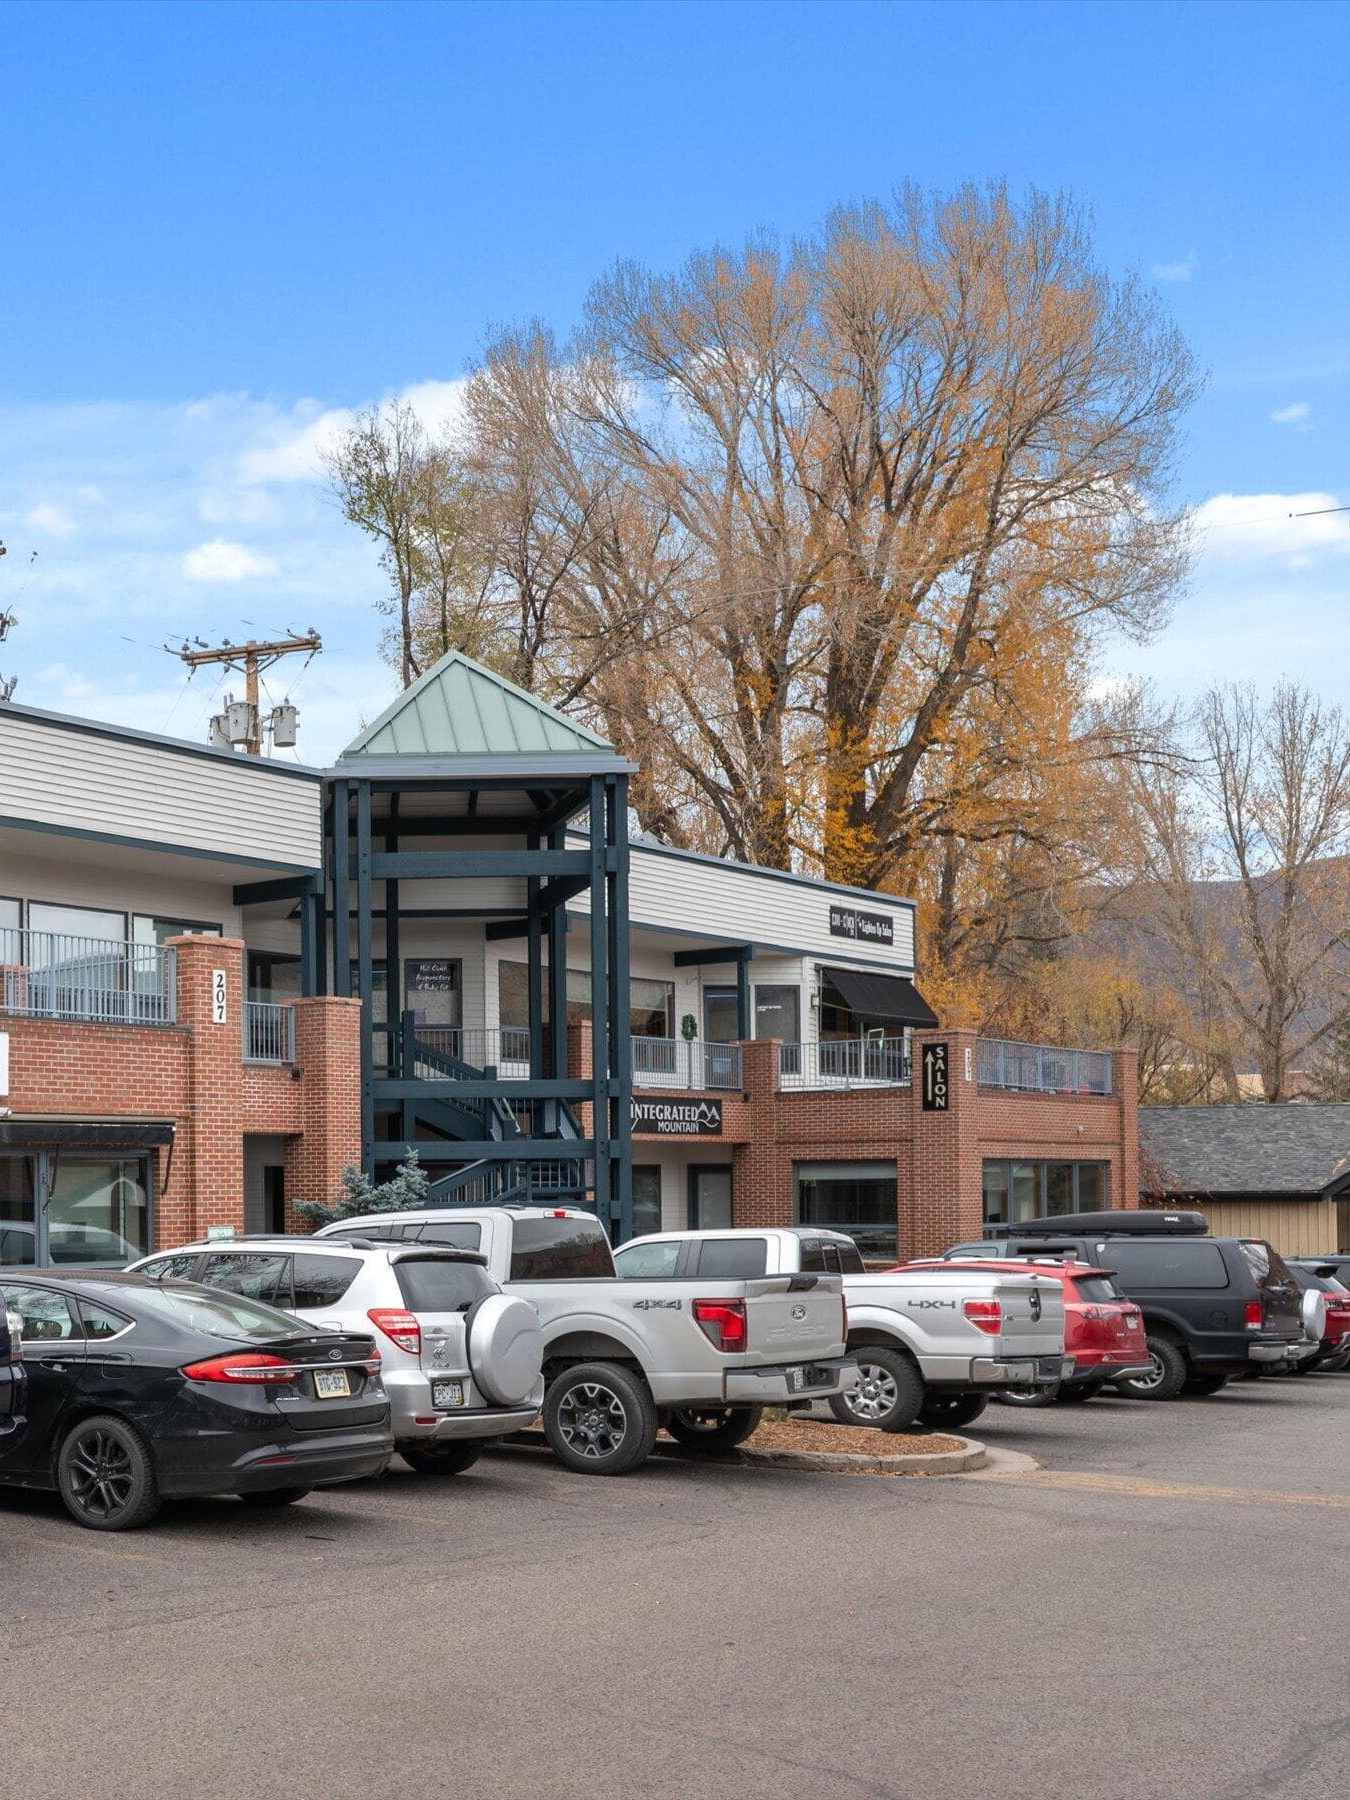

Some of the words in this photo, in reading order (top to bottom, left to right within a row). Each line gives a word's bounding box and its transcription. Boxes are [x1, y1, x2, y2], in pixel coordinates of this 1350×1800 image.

[216, 974, 225, 1020] 207
[934, 1046, 946, 1108] SALON
[630, 1103, 698, 1121] INTEGRATED
[657, 1121, 699, 1133] MOUNTAIN
